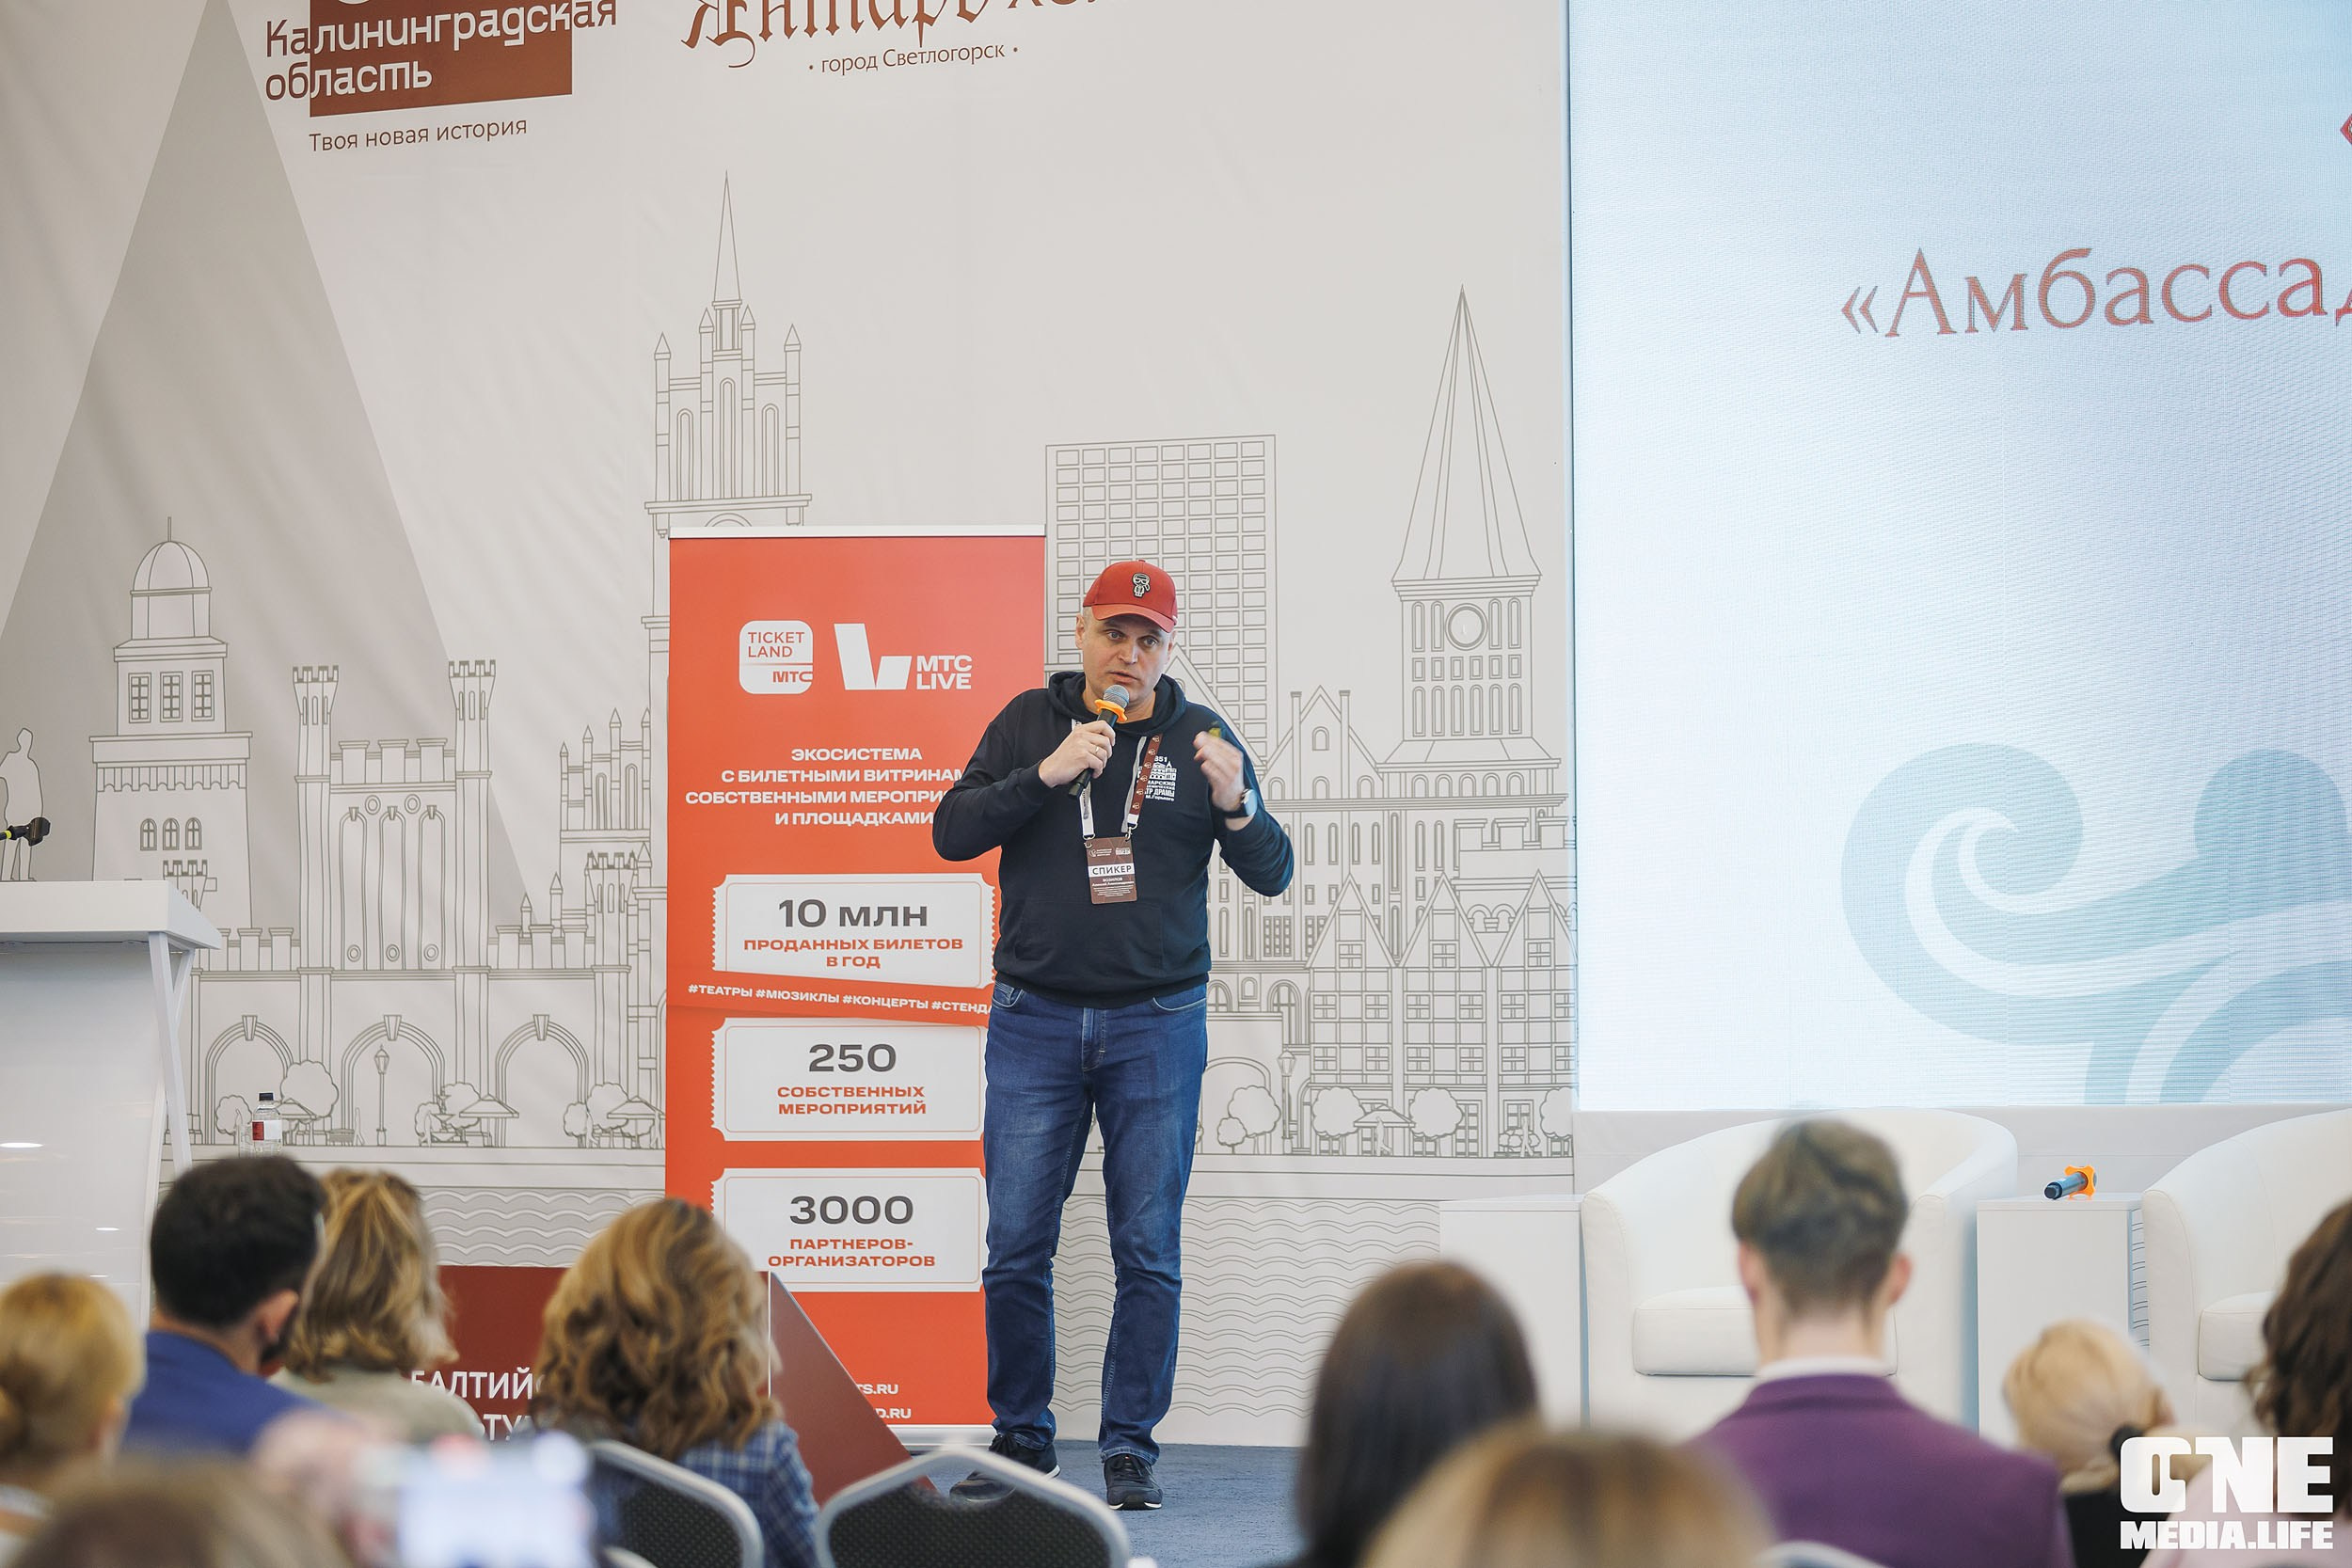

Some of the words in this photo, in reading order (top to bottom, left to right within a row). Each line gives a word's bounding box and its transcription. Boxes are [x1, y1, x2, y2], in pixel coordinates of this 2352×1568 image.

[265, 0, 616, 57] Калининградская
[821, 55, 879, 76] город
[882, 43, 1006, 68] Светлогорск
[265, 59, 433, 102] область
[309, 133, 358, 152] Твоя
[365, 128, 429, 148] новая
[437, 119, 527, 142] история
[747, 631, 805, 644] TICKET
[748, 645, 793, 658] LAND
[916, 655, 973, 673] МТС
[916, 673, 972, 690] LIVE
[791, 747, 923, 762] ЭКОСИСТЕМА
[721, 769, 735, 783] С
[738, 768, 861, 783] БИЛЕТНЫМИ
[685, 790, 847, 804] СОБСТВЕННЫМИ
[850, 789, 948, 804] МЕРОПРИ
[774, 812, 789, 825] И
[792, 811, 934, 827] ПЛОЩАДКАМИ
[1092, 864, 1132, 875] СПИКЕР
[778, 898, 827, 928] 10
[743, 939, 869, 953] ПРОДАННЫХ
[873, 938, 963, 950] БИЛЕТОВ
[826, 956, 838, 967] В
[842, 956, 882, 970] ГОД
[688, 984, 754, 998] #ТЕАТРЫ
[755, 989, 840, 1004] #МЮЗИКЛЫ
[842, 994, 929, 1009] #КОНЦЕРТЫ
[931, 1000, 992, 1015] #СТЕНД
[808, 1043, 897, 1073] 250
[777, 1086, 925, 1098] СОБСТВЕННЫХ
[778, 1100, 927, 1115] МЕРОПРИЯТИЙ
[789, 1196, 914, 1225] 3000
[789, 1238, 914, 1250] ПАРТНЕРОВ-
[768, 1255, 935, 1267] ОРГАНИЗАТОРОВ
[411, 1367, 545, 1400] БАЛТИЙ
